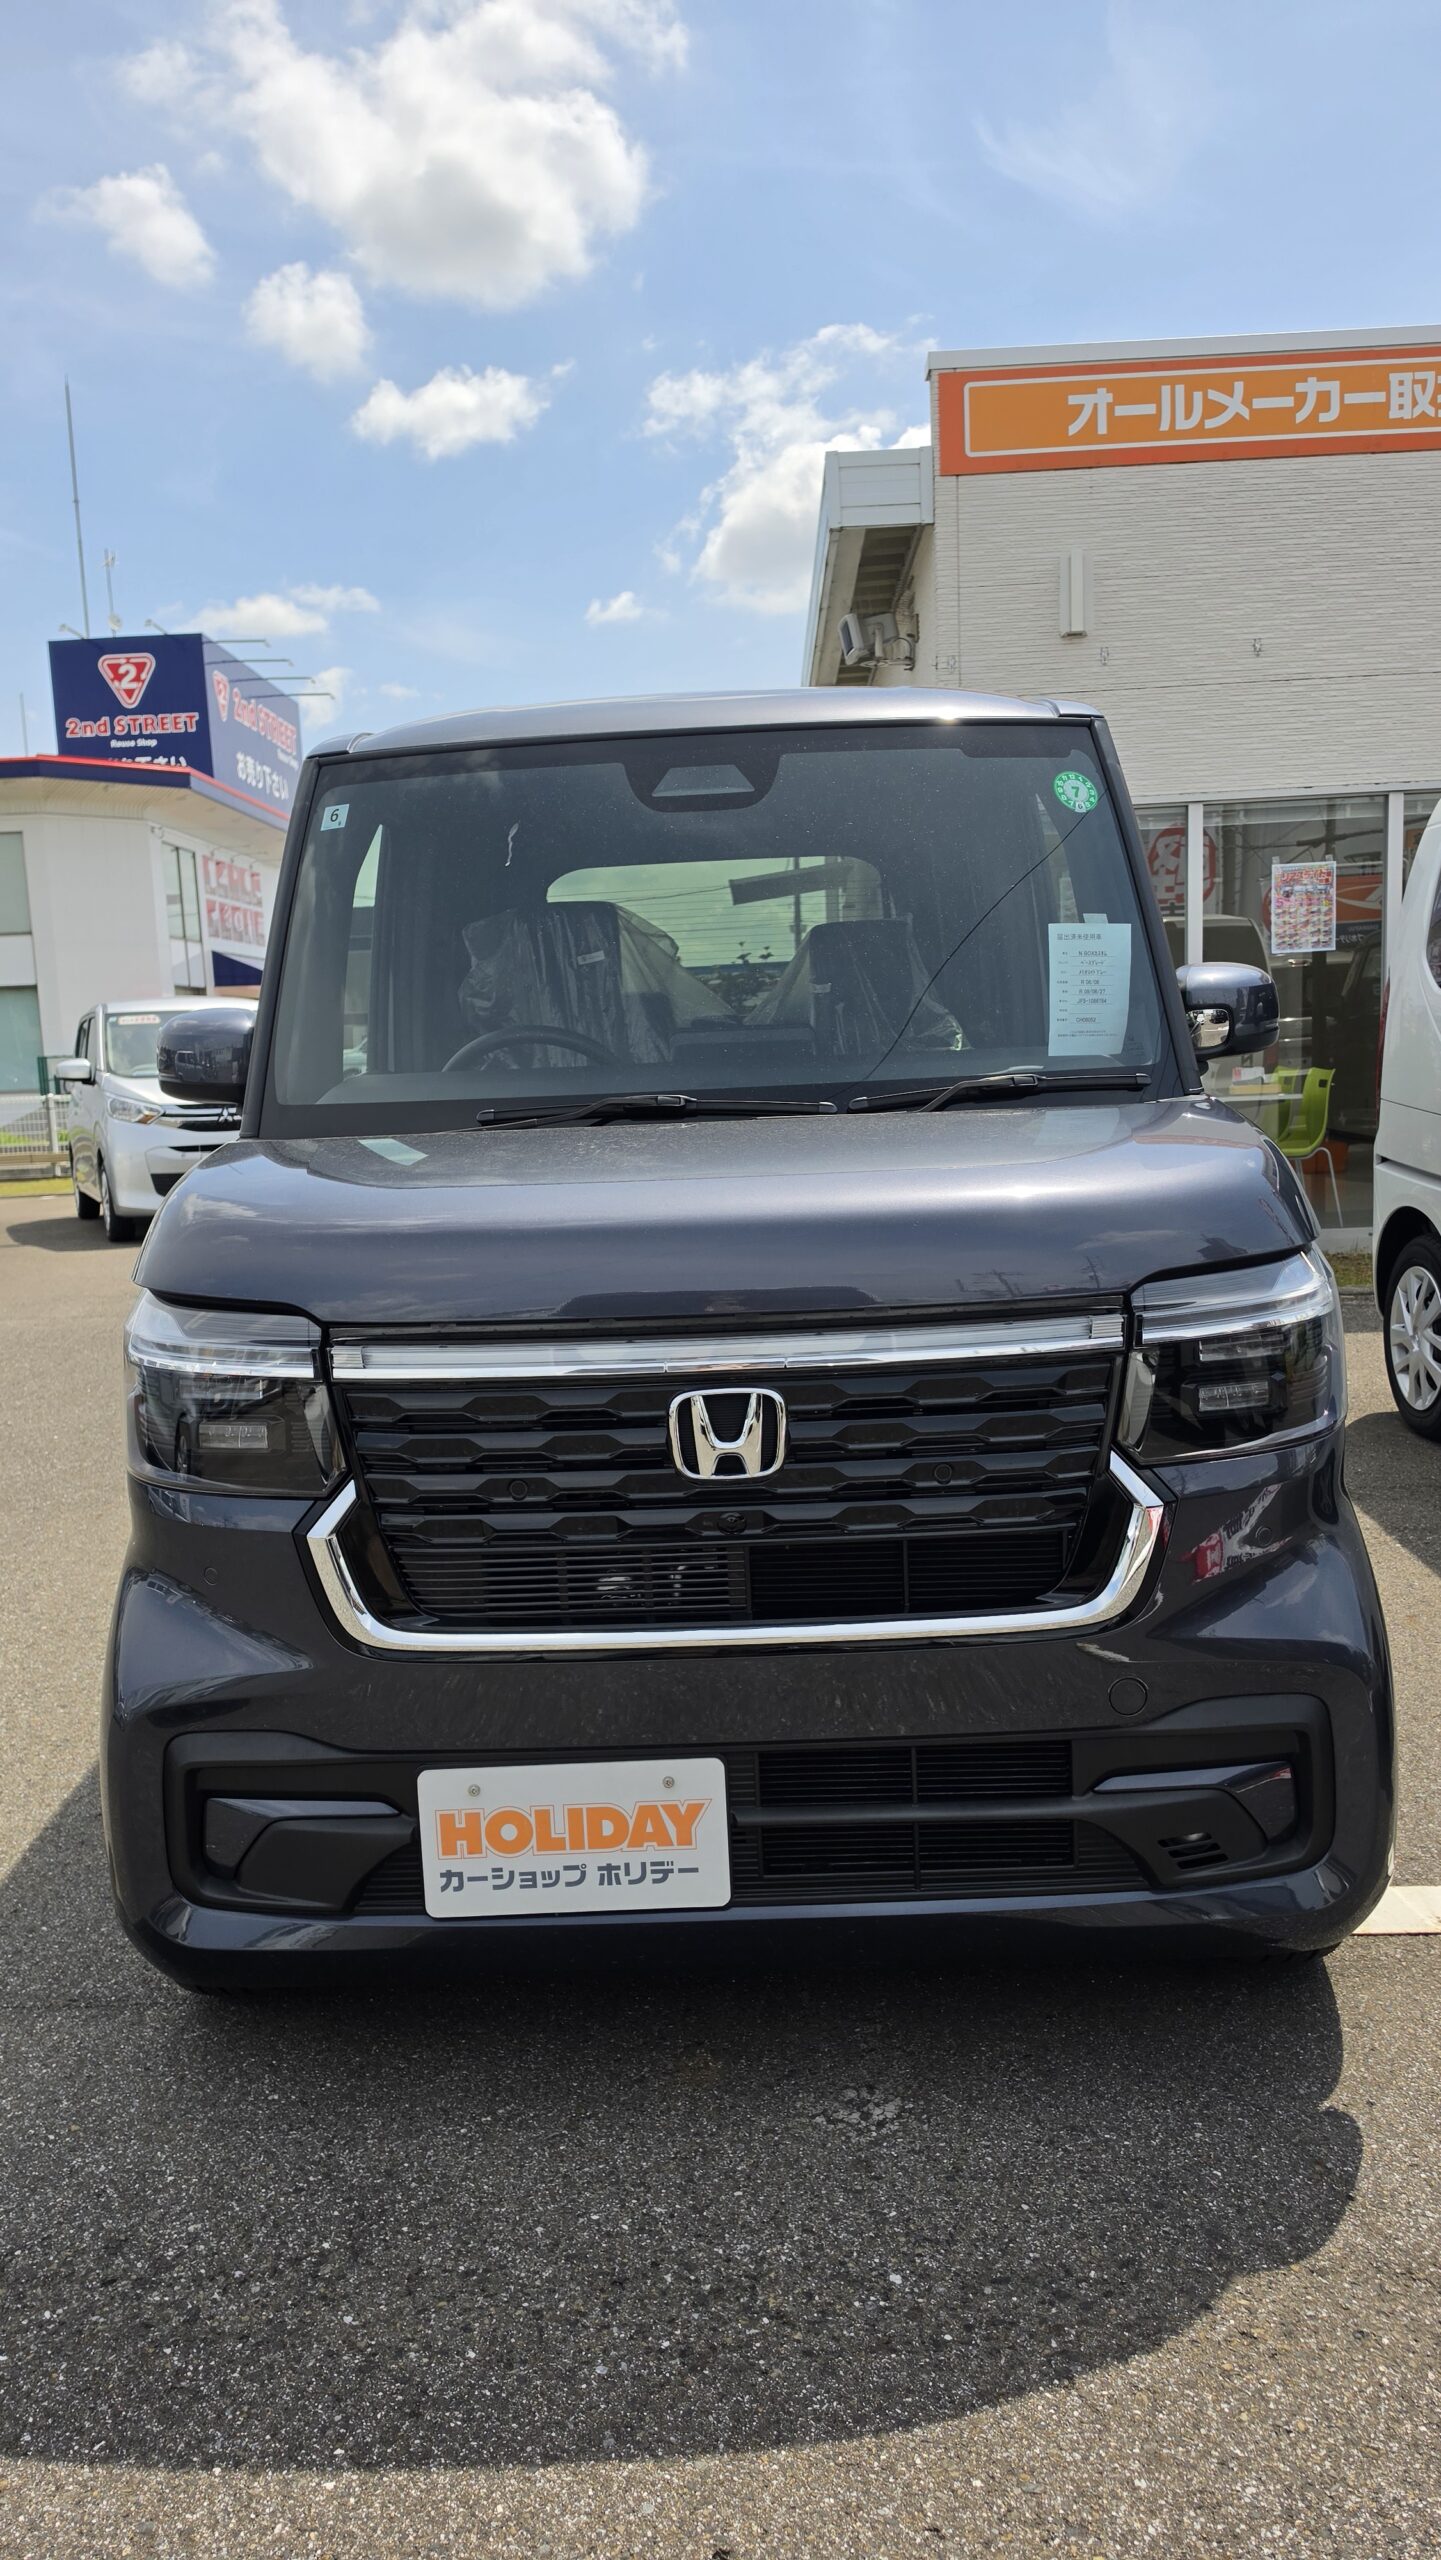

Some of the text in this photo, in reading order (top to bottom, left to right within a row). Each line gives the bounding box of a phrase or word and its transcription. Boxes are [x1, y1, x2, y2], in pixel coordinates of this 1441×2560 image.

[1067, 371, 1441, 436] オールメーカー取
[65, 712, 199, 738] 2nd STREET
[232, 687, 297, 756] 2nd STREET
[1071, 786, 1080, 798] 7
[330, 808, 340, 822] 6
[436, 1800, 710, 1859] HOLIDAY
[439, 1860, 699, 1893] カーショップ ホリデー
